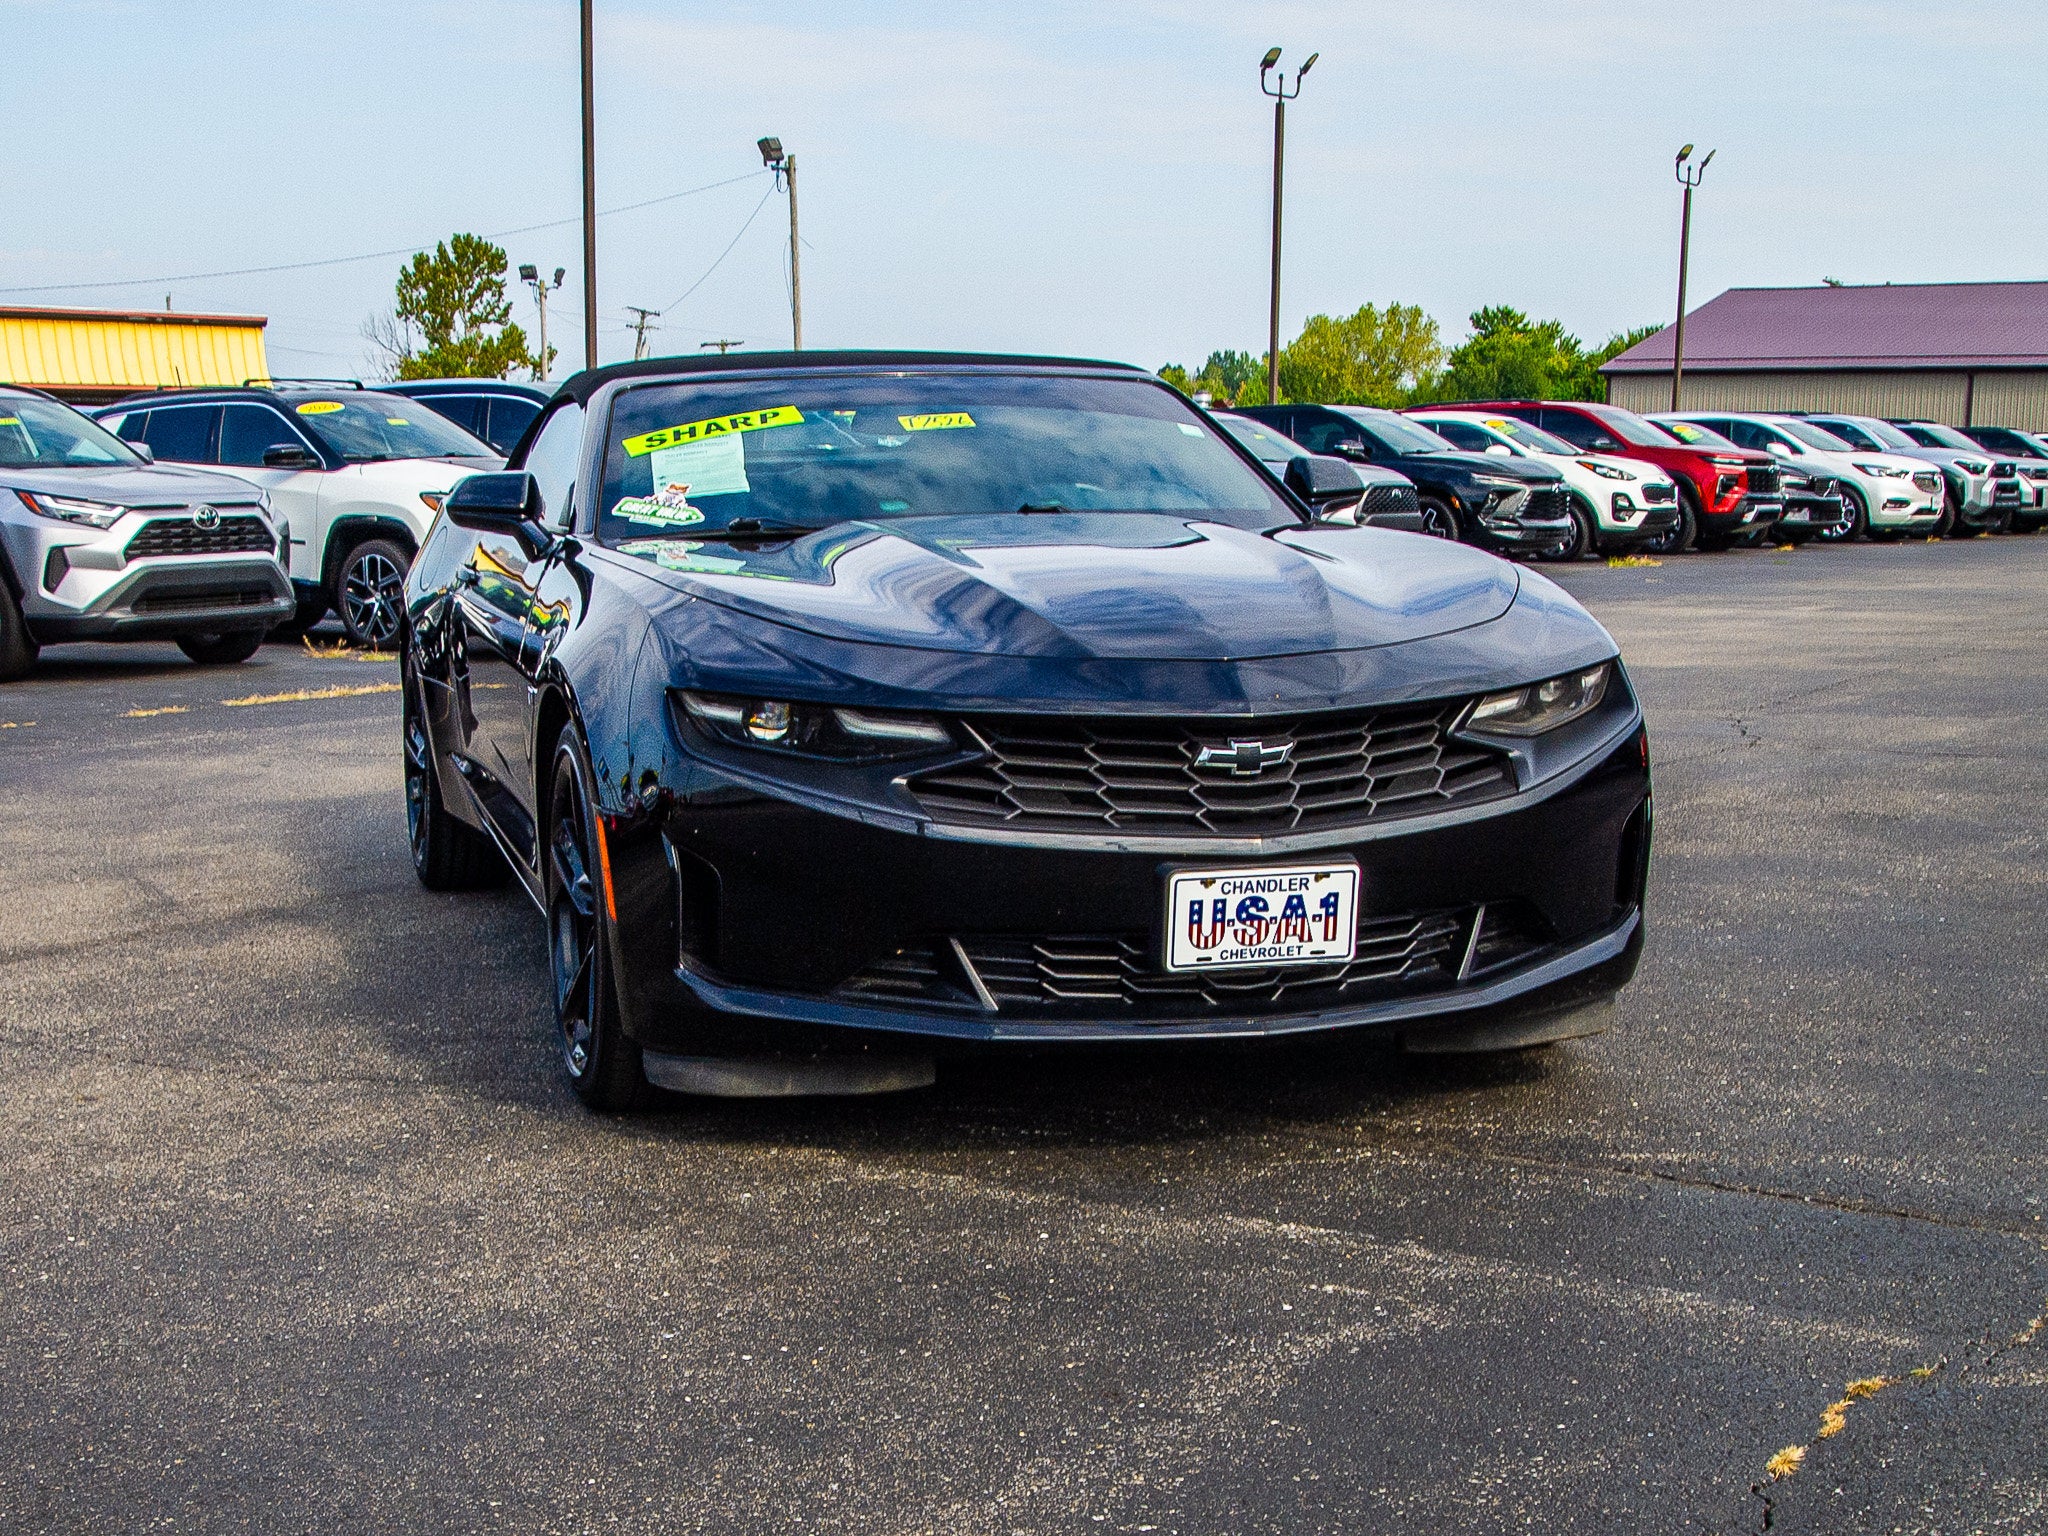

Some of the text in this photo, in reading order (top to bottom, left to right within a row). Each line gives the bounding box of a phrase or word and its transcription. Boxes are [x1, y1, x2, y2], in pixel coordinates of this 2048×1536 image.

[645, 411, 780, 448] SHARP
[1220, 877, 1311, 896] CHANDLER
[1220, 945, 1304, 961] CHEVROLET
